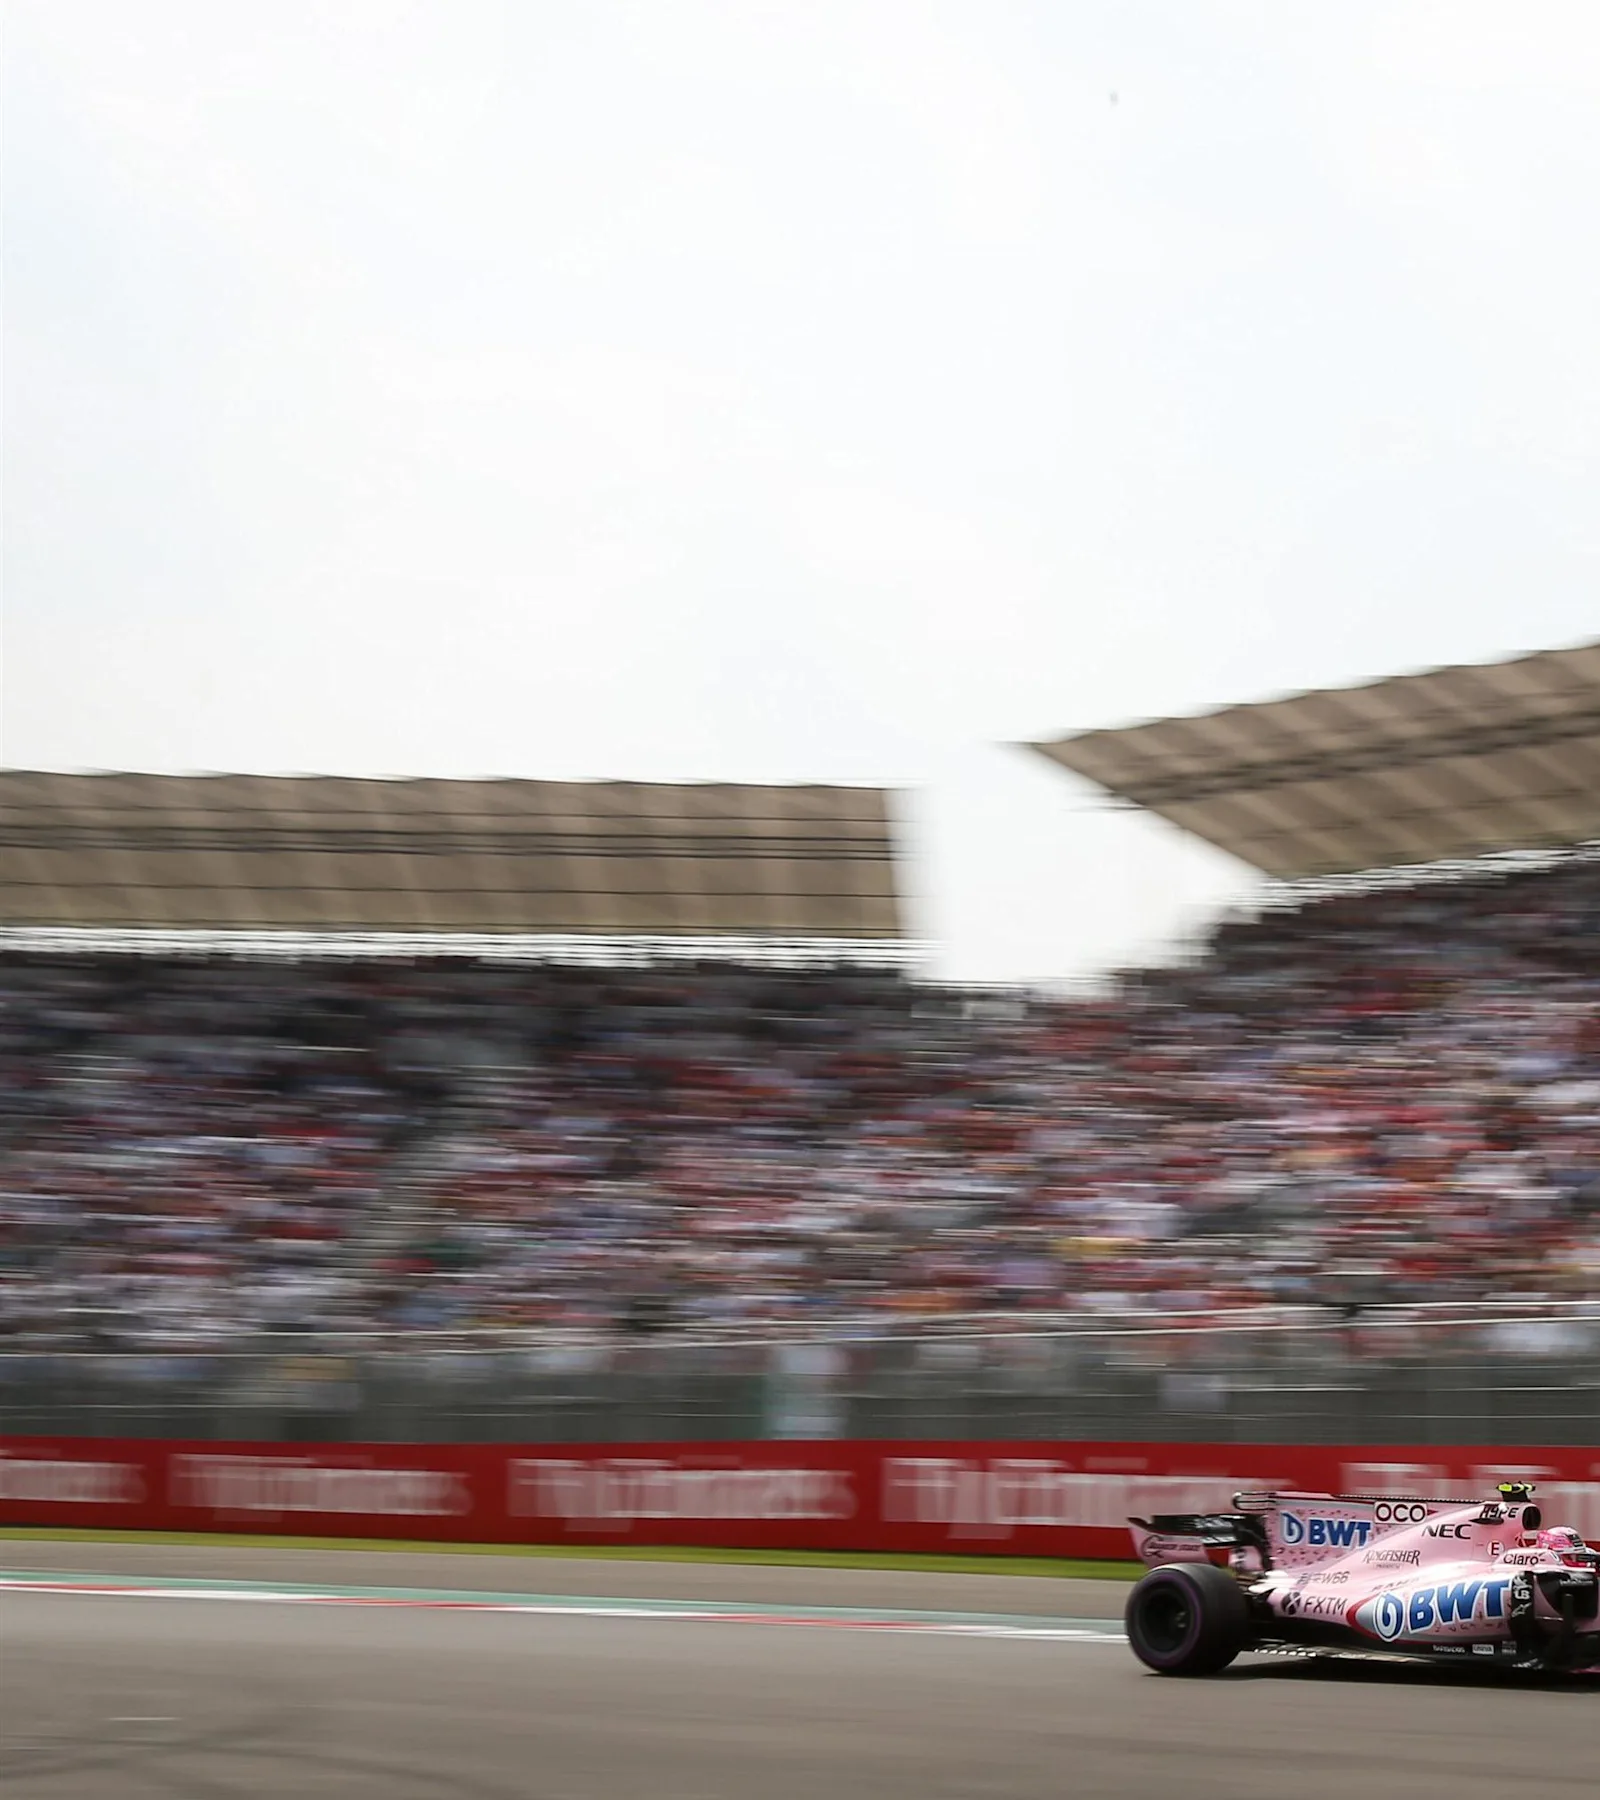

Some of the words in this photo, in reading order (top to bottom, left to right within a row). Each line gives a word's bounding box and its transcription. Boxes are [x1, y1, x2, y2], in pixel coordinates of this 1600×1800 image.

[1375, 1503, 1426, 1522] OCO
[1308, 1518, 1372, 1547] BWT
[1422, 1523, 1472, 1540] NEC
[1362, 1550, 1421, 1567] KINGFISHER
[1491, 1542, 1500, 1556] E
[1304, 1596, 1348, 1616] FXTM
[1409, 1579, 1511, 1632] BWT
